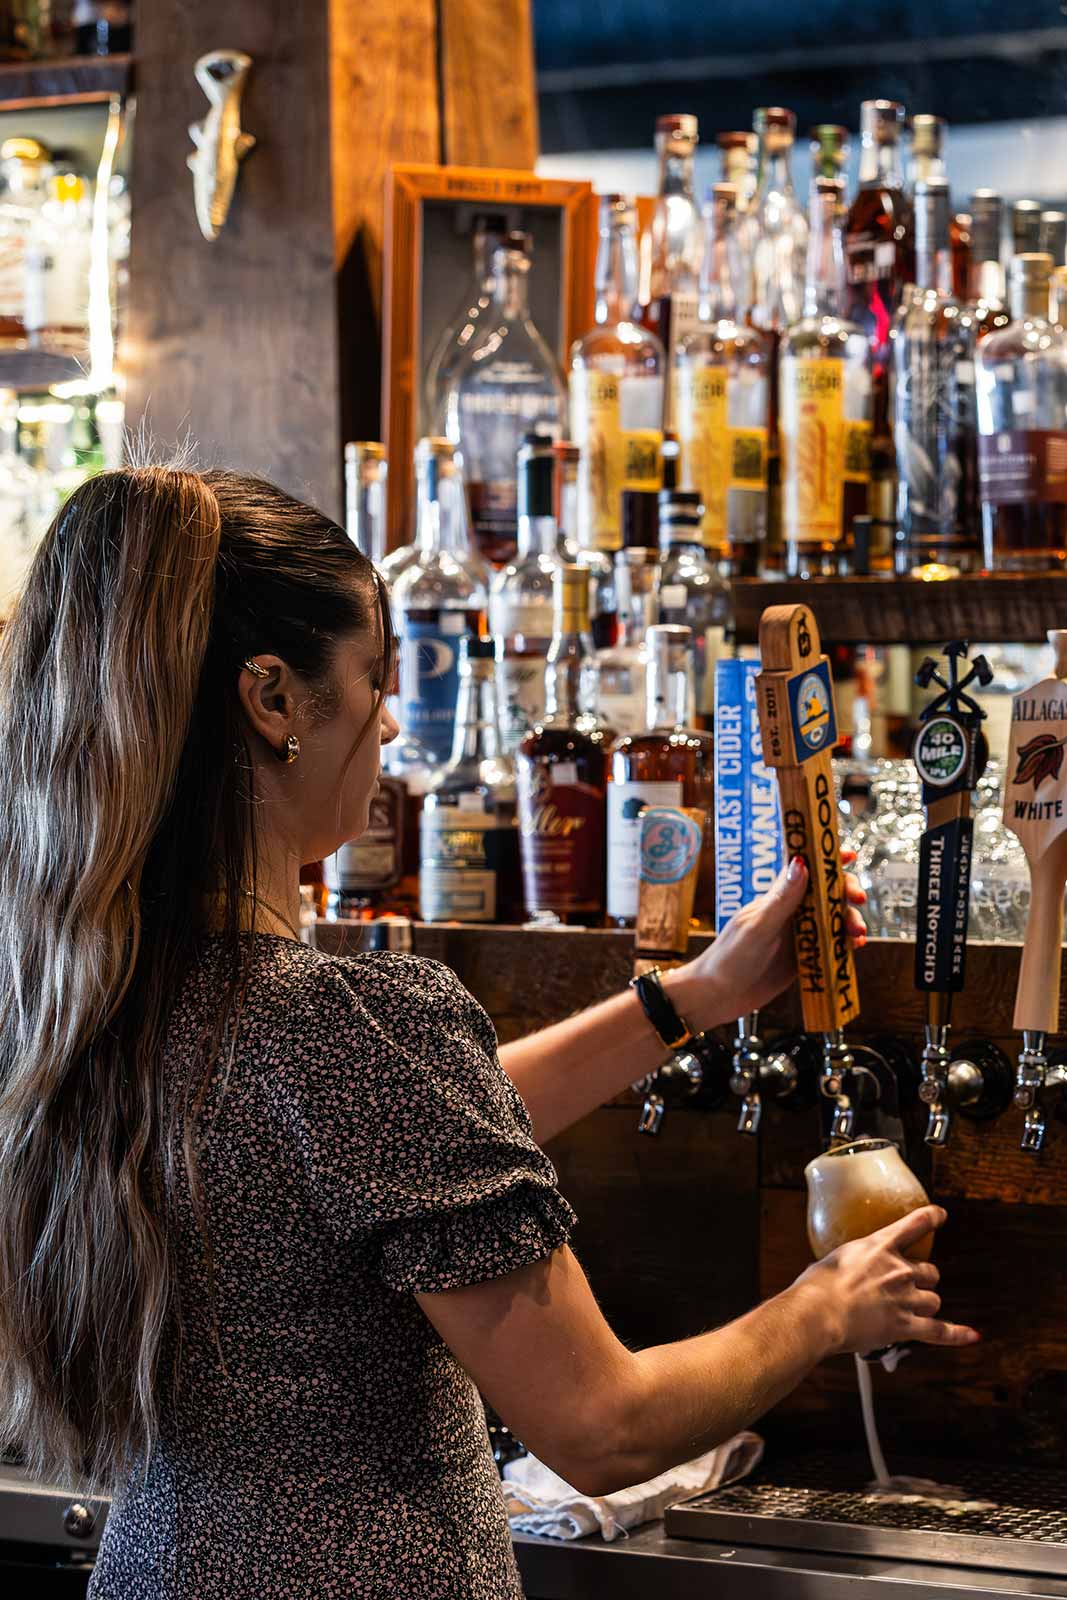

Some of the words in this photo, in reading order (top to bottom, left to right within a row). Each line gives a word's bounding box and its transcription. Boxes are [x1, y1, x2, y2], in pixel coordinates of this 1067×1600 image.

[1012, 699, 1067, 721] ALLAGA
[718, 704, 742, 776] CIDER
[921, 745, 961, 761] MILE
[930, 733, 955, 745] 40
[1014, 799, 1063, 820] WHITE
[719, 784, 742, 918] DOWNEAST
[927, 836, 945, 901] THREE
[815, 773, 853, 1013] HARDYWOOD
[952, 933, 964, 974] MARK
